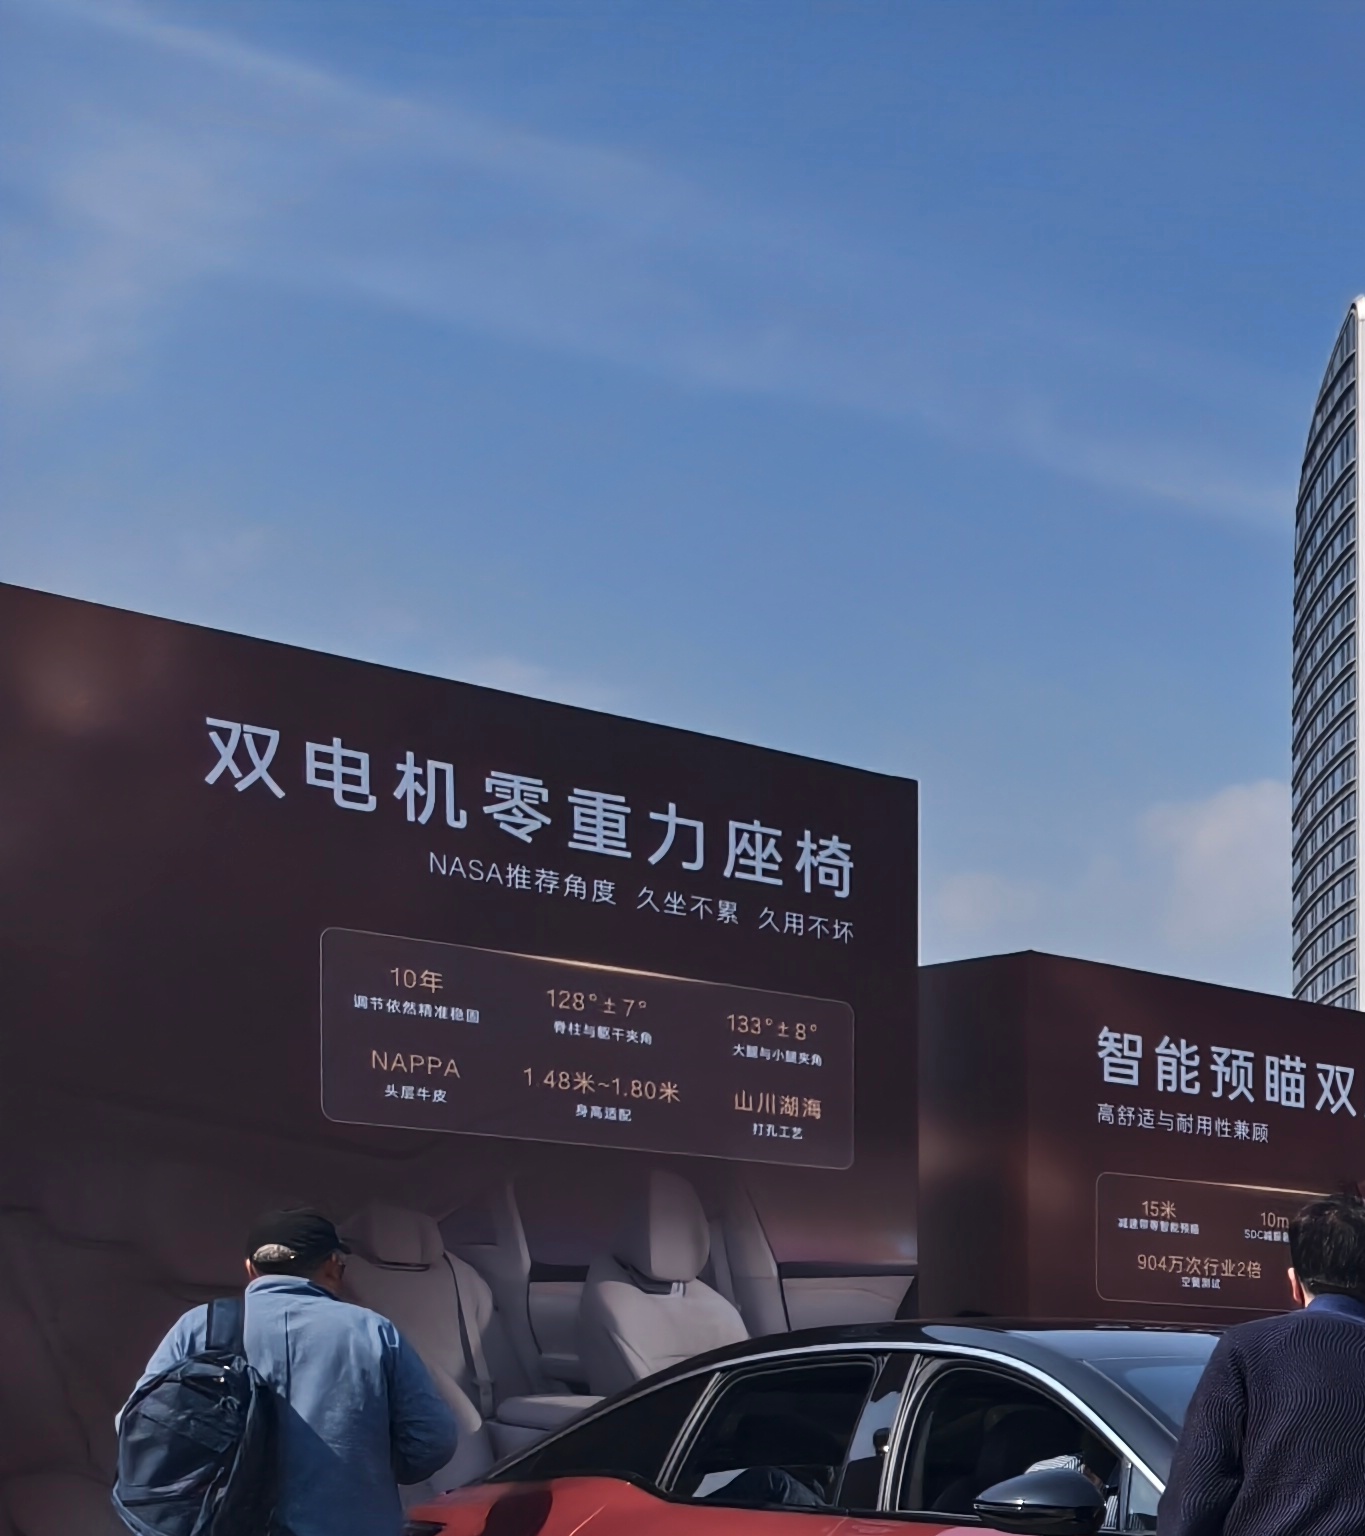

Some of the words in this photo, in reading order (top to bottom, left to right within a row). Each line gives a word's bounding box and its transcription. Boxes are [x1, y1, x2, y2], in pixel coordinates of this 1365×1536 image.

[204, 716, 855, 898] 双电机零重力座椅
[429, 846, 620, 905] NASA推荐角度
[636, 886, 739, 925] 久坐不累
[758, 906, 854, 945] 久用不坏
[390, 967, 444, 994] 10年
[371, 1049, 461, 1079] NAPPA
[384, 1083, 447, 1103] 头层牛皮
[523, 1067, 681, 1104] 1.48米~1.80米
[734, 1089, 822, 1120] 山川湖海
[752, 1122, 803, 1140] 打孔工艺
[1097, 1102, 1269, 1144] 高舒适与耐用性兼顾
[1141, 1200, 1177, 1220] 15米
[1137, 1253, 1262, 1279] 904万次行业2倍
